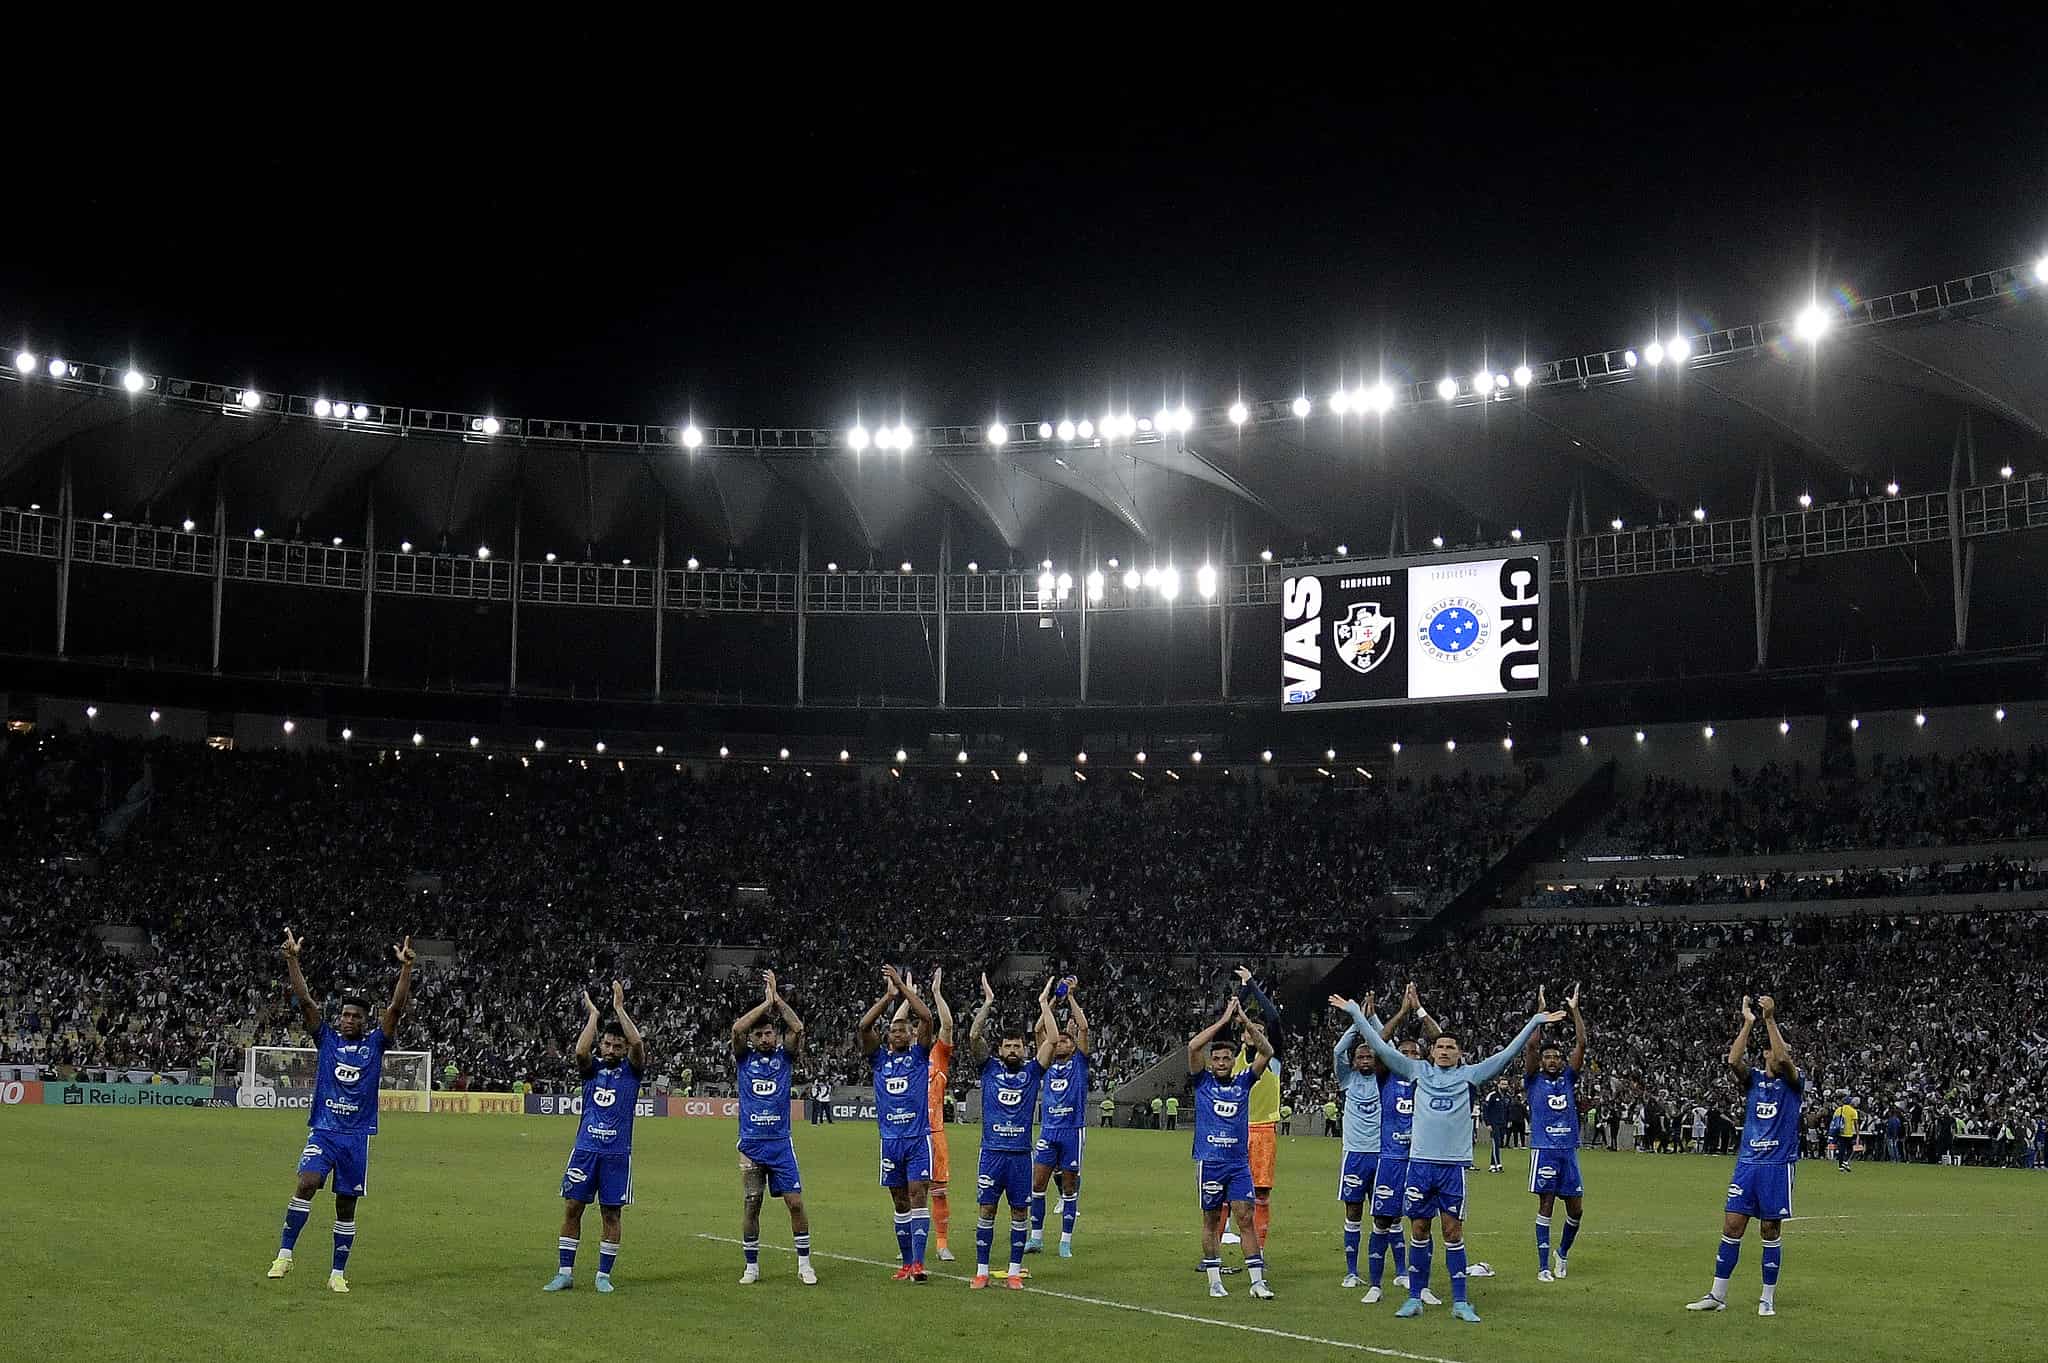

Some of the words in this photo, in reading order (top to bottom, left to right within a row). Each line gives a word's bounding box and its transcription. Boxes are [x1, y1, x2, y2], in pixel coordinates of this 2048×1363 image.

[1424, 598, 1484, 620] CRUZEIRO
[1500, 557, 1539, 692] CRU
[1283, 575, 1322, 705] VAS
[1419, 627, 1460, 661] ESPORTE
[1464, 622, 1489, 658] CLUBE
[89, 1088, 116, 1105] Rei
[118, 1093, 137, 1105] do
[138, 1090, 195, 1106] Pitaco
[685, 1102, 714, 1116] GOL
[832, 1105, 857, 1118] CBF
